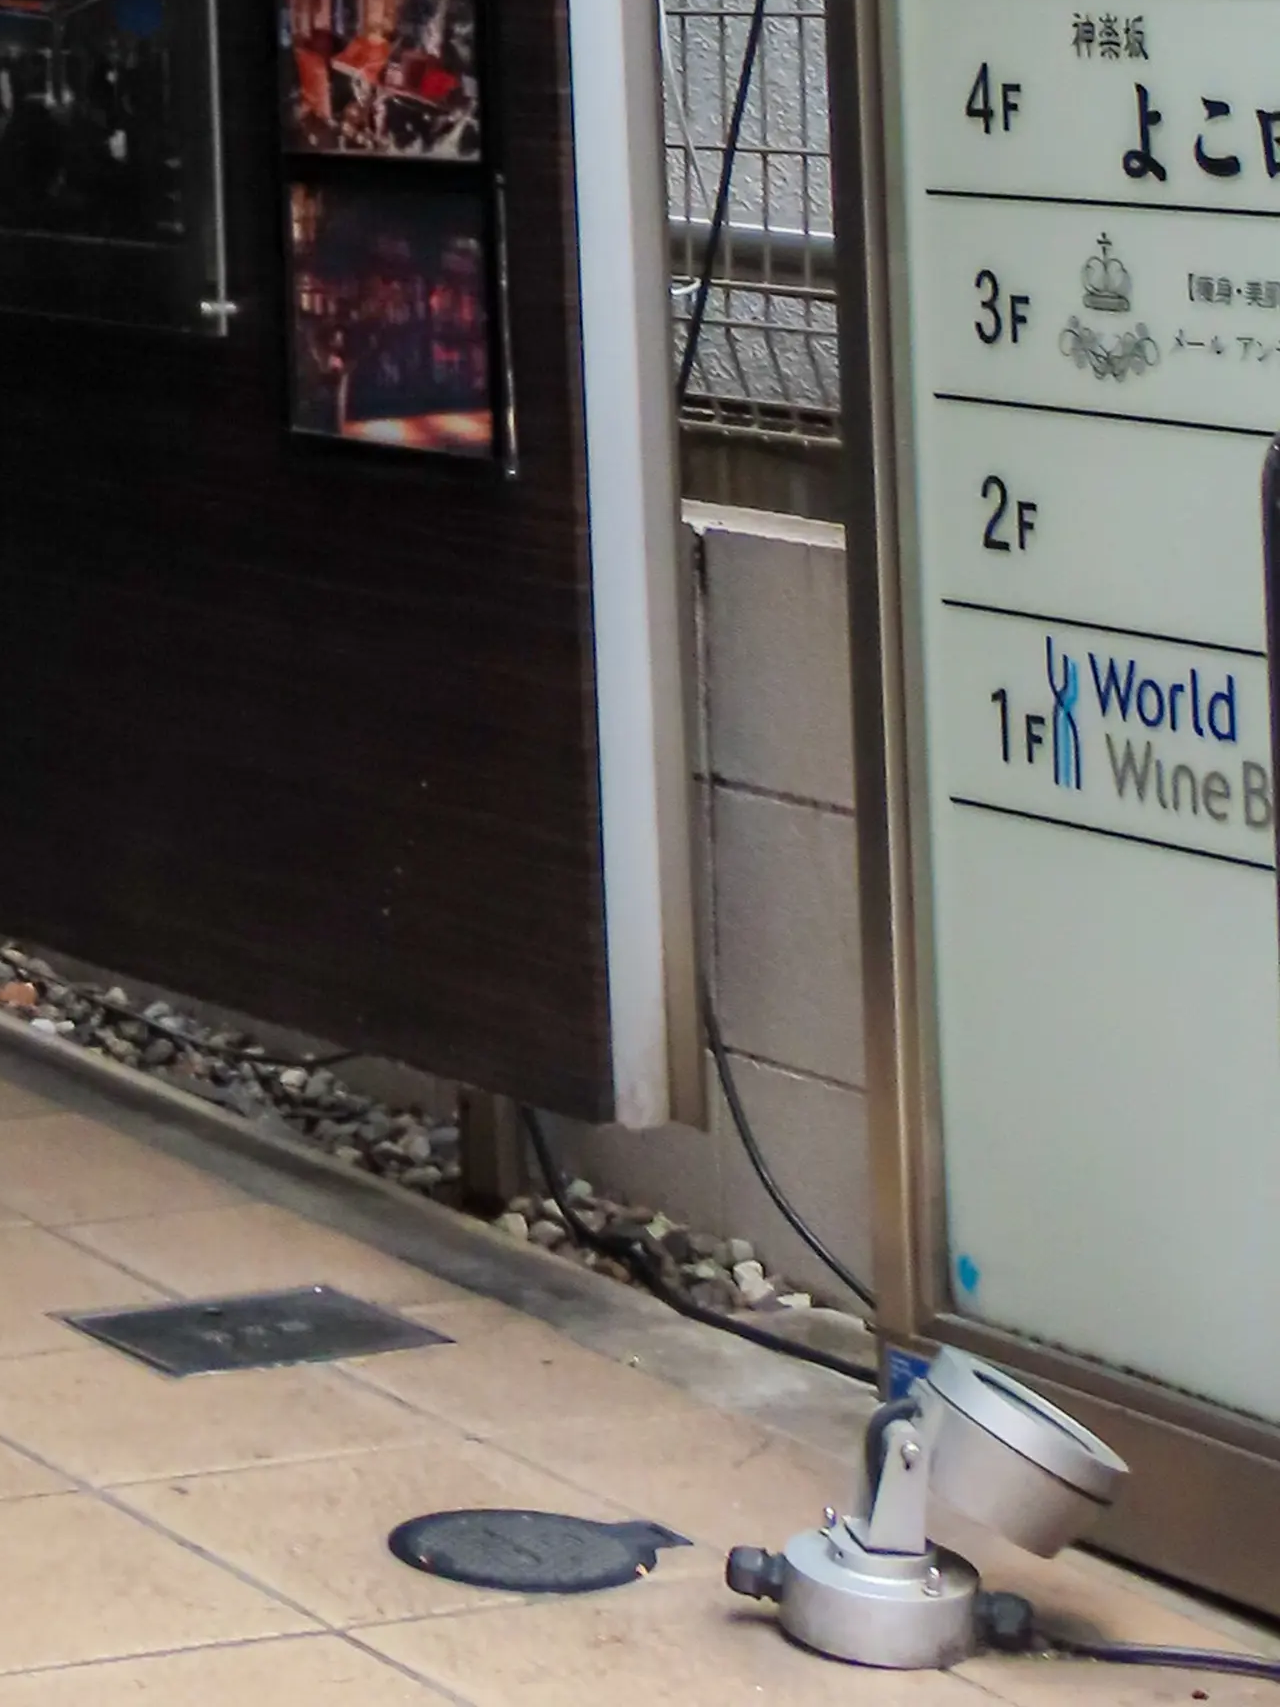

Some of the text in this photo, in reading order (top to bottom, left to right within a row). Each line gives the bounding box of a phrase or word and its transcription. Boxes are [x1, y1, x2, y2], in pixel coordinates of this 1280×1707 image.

[965, 62, 1021, 135] 4F
[973, 269, 1030, 346] 3F
[981, 474, 1037, 553] 2F
[990, 687, 1045, 765] 1F
[1088, 653, 1237, 743] World
[1105, 733, 1230, 822] Wine
